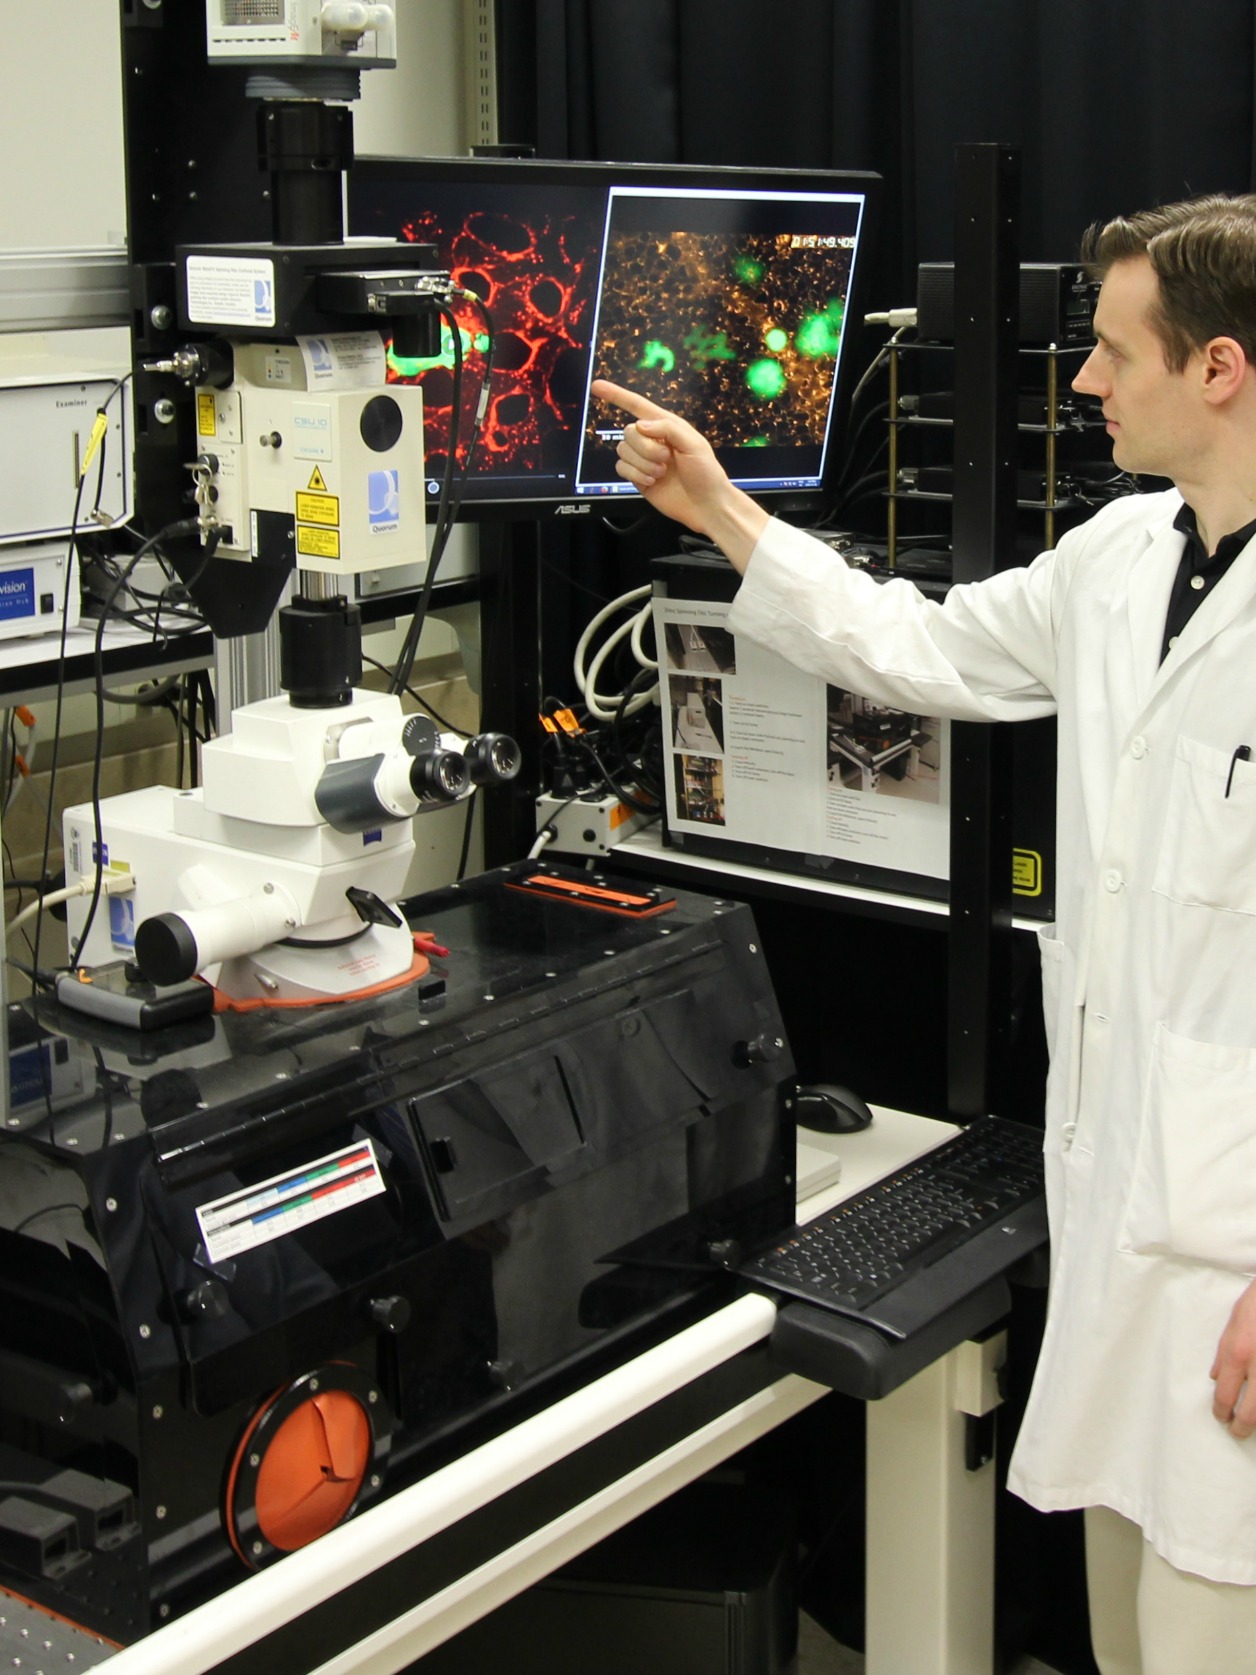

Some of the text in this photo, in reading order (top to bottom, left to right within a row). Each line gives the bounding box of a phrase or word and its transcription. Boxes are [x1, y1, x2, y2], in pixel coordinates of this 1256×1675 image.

[56, 400, 87, 408] Examiner
[554, 504, 591, 514] ASUS
[372, 522, 398, 533] Quorum
